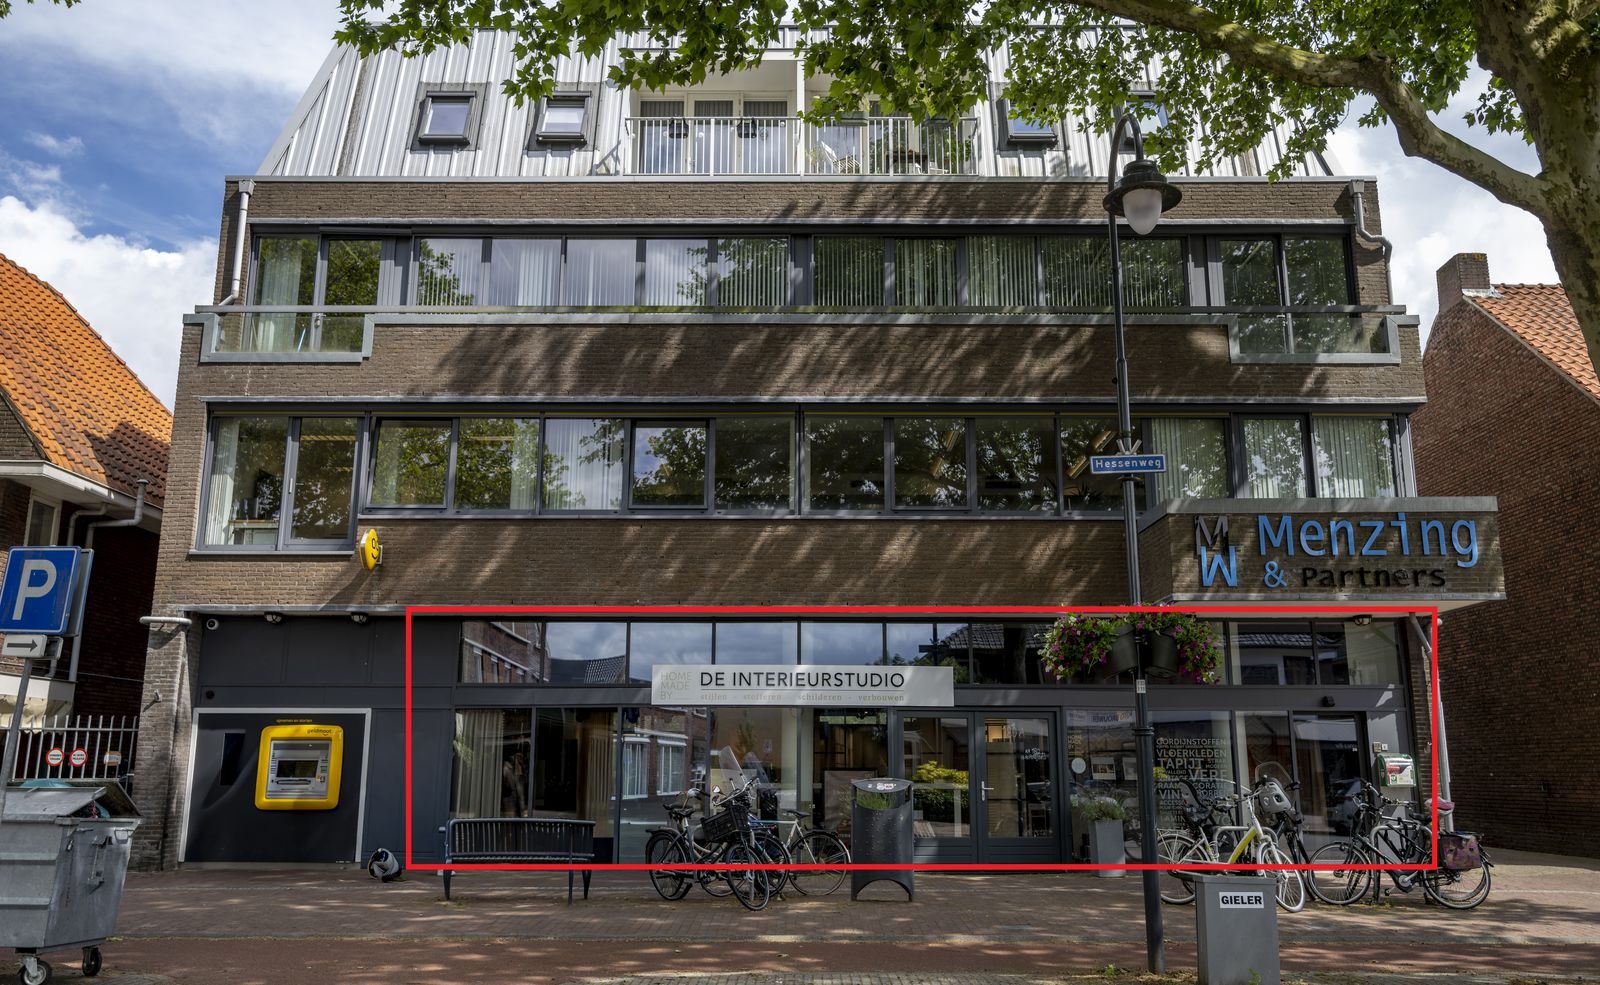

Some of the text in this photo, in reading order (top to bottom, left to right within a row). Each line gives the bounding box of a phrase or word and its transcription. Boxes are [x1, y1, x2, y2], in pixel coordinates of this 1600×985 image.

[1095, 459, 1161, 469] Hessenweg
[1257, 512, 1479, 568] Menzing
[1264, 561, 1446, 588] & Partners
[12, 559, 57, 621] P
[660, 671, 692, 681] HOME
[700, 672, 905, 688] DE INTERIEURSTUDIO
[660, 681, 690, 690] MADE
[660, 690, 673, 700] BY
[743, 692, 782, 701] stofferen
[798, 692, 842, 701] schilderen
[858, 693, 905, 702] verbouwen
[1156, 748, 1227, 758] VLOERKLEDEN
[1157, 758, 1205, 770] TAPIJT
[1221, 895, 1263, 905] GIELER
